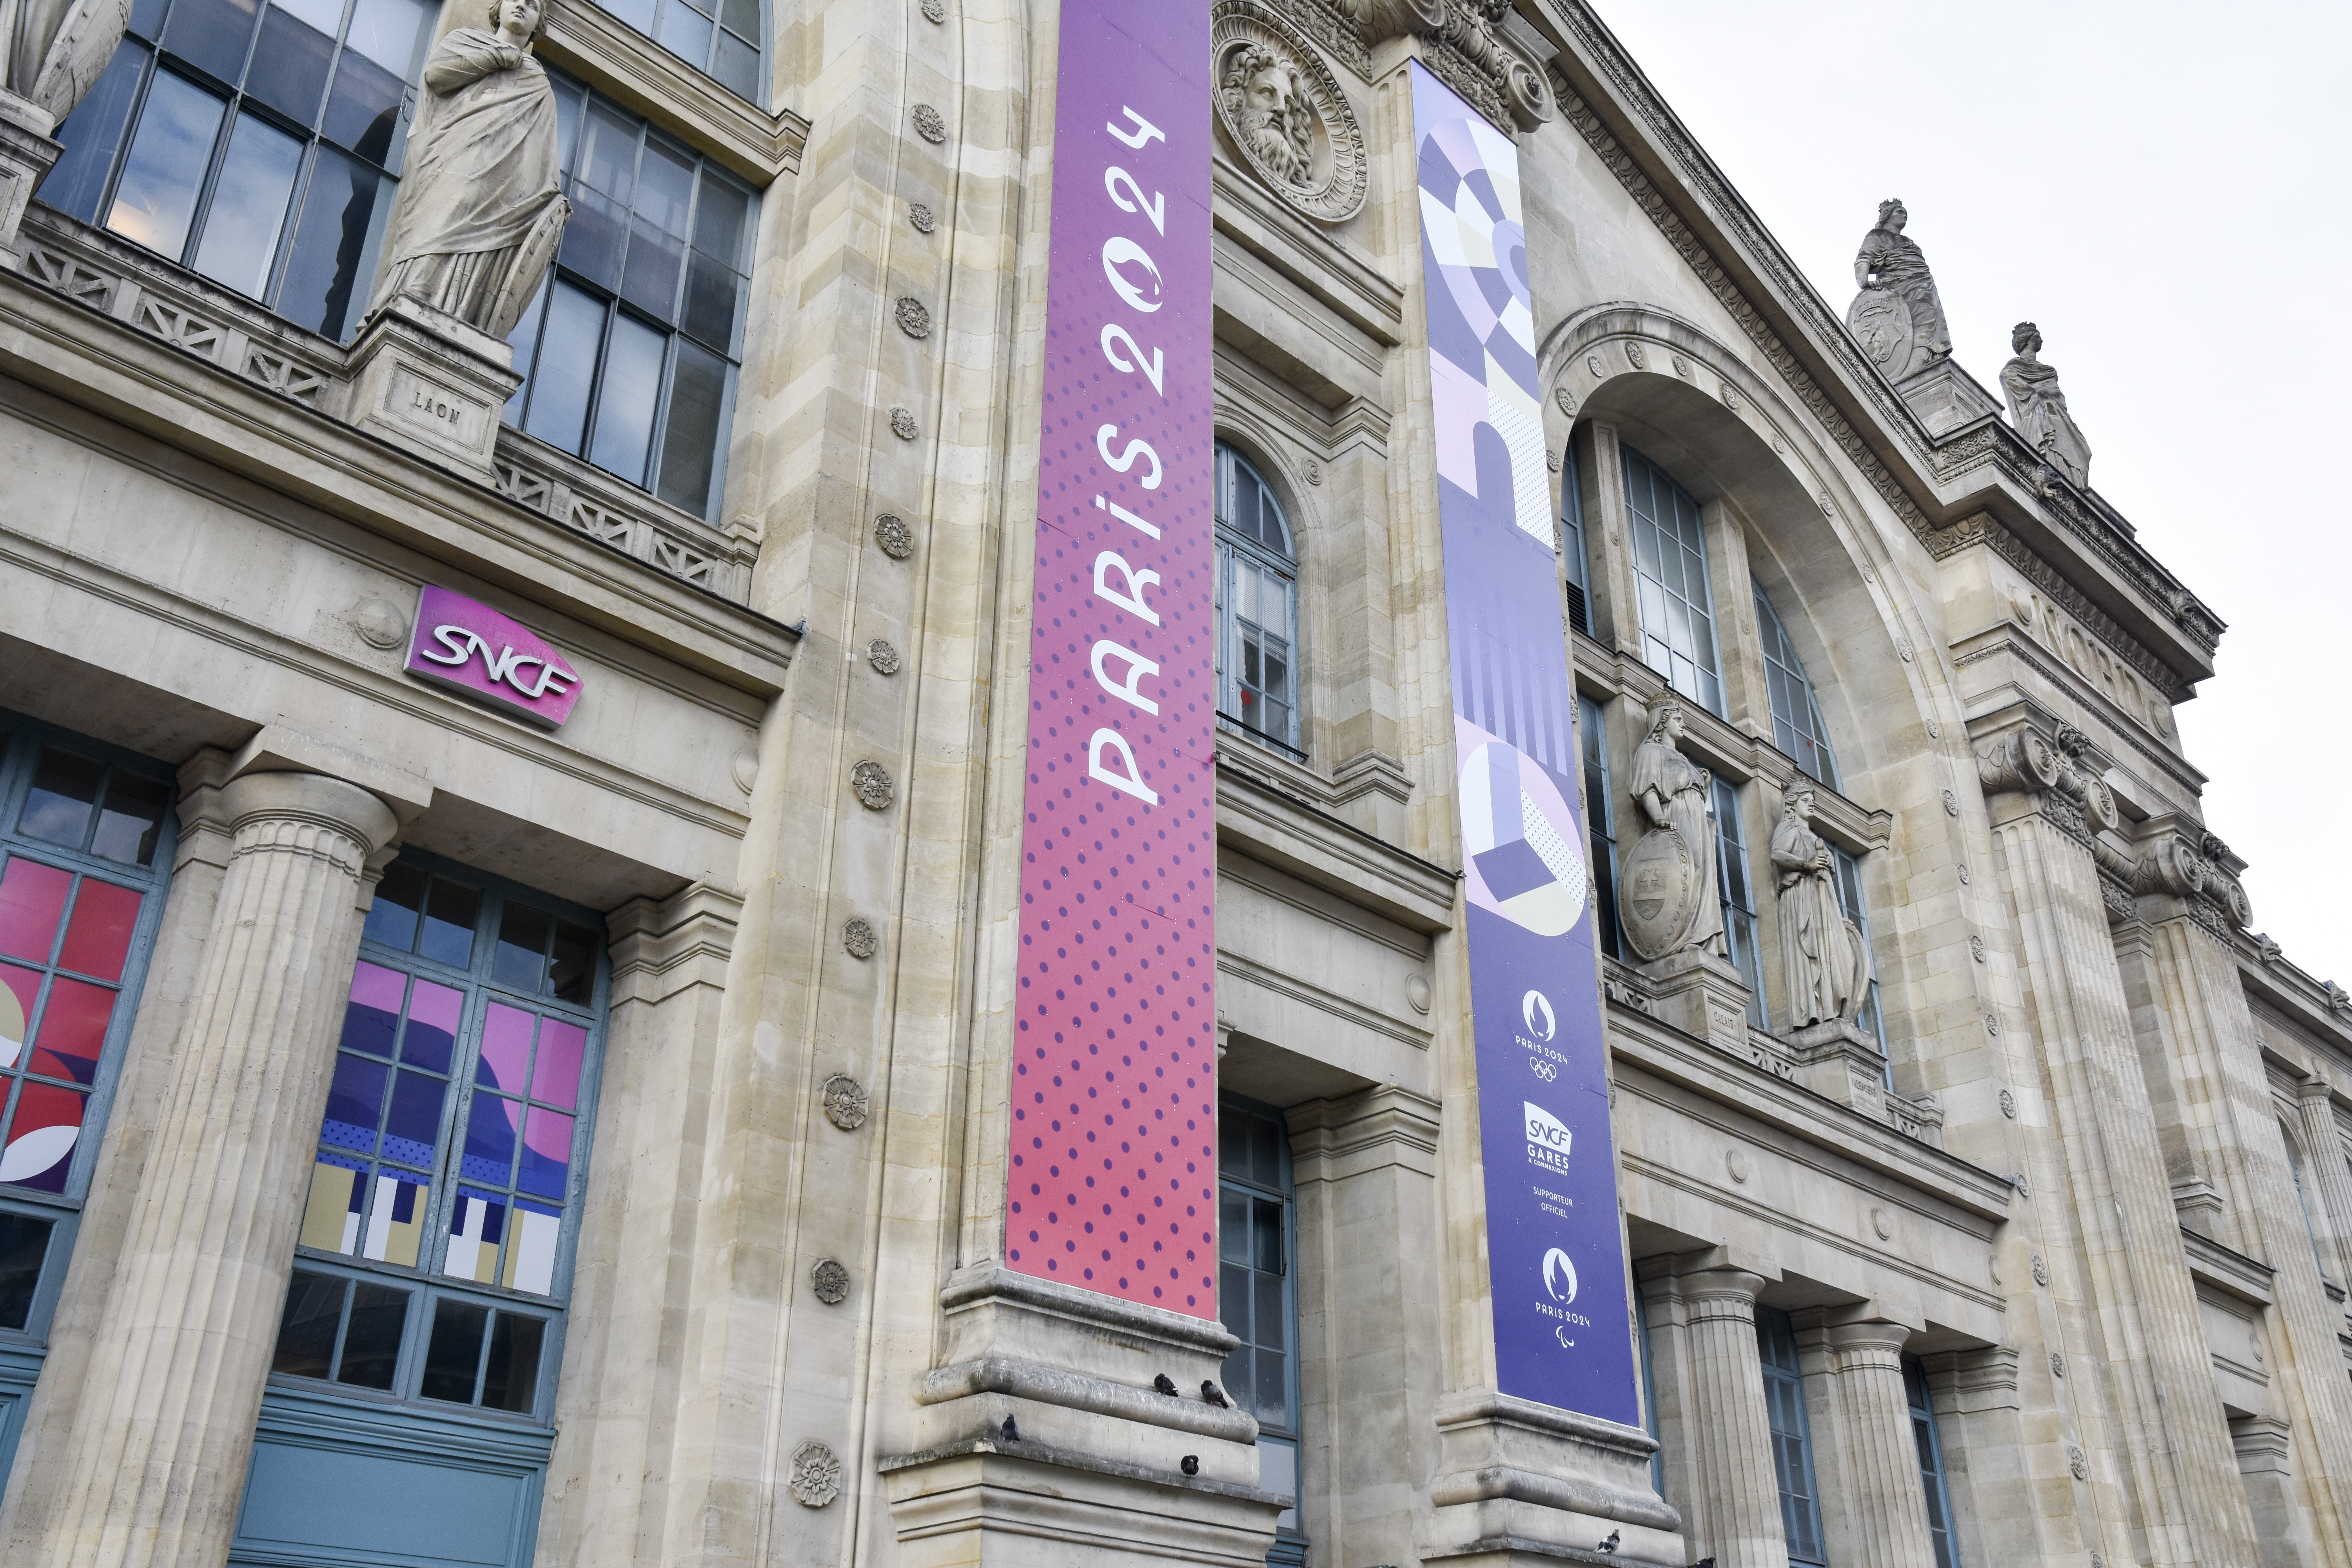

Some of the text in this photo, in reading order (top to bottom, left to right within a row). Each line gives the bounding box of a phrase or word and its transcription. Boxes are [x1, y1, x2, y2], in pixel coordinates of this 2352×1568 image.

[1101, 105, 1165, 397] 2024
[414, 392, 460, 425] LAON
[421, 625, 578, 700] SNCF
[2031, 592, 2148, 726] NORD
[1714, 1012, 1733, 1029] CALAIS
[1544, 1047, 1568, 1065] 2024
[1529, 1120, 1568, 1146] SNCF
[1527, 1144, 1569, 1169] GARES
[1534, 1159, 1568, 1176] CONNEXIONS
[1533, 1186, 1573, 1207] SUPPORTEUR
[1541, 1202, 1568, 1218] OFFICIEL
[1566, 1311, 1590, 1327] 2024
